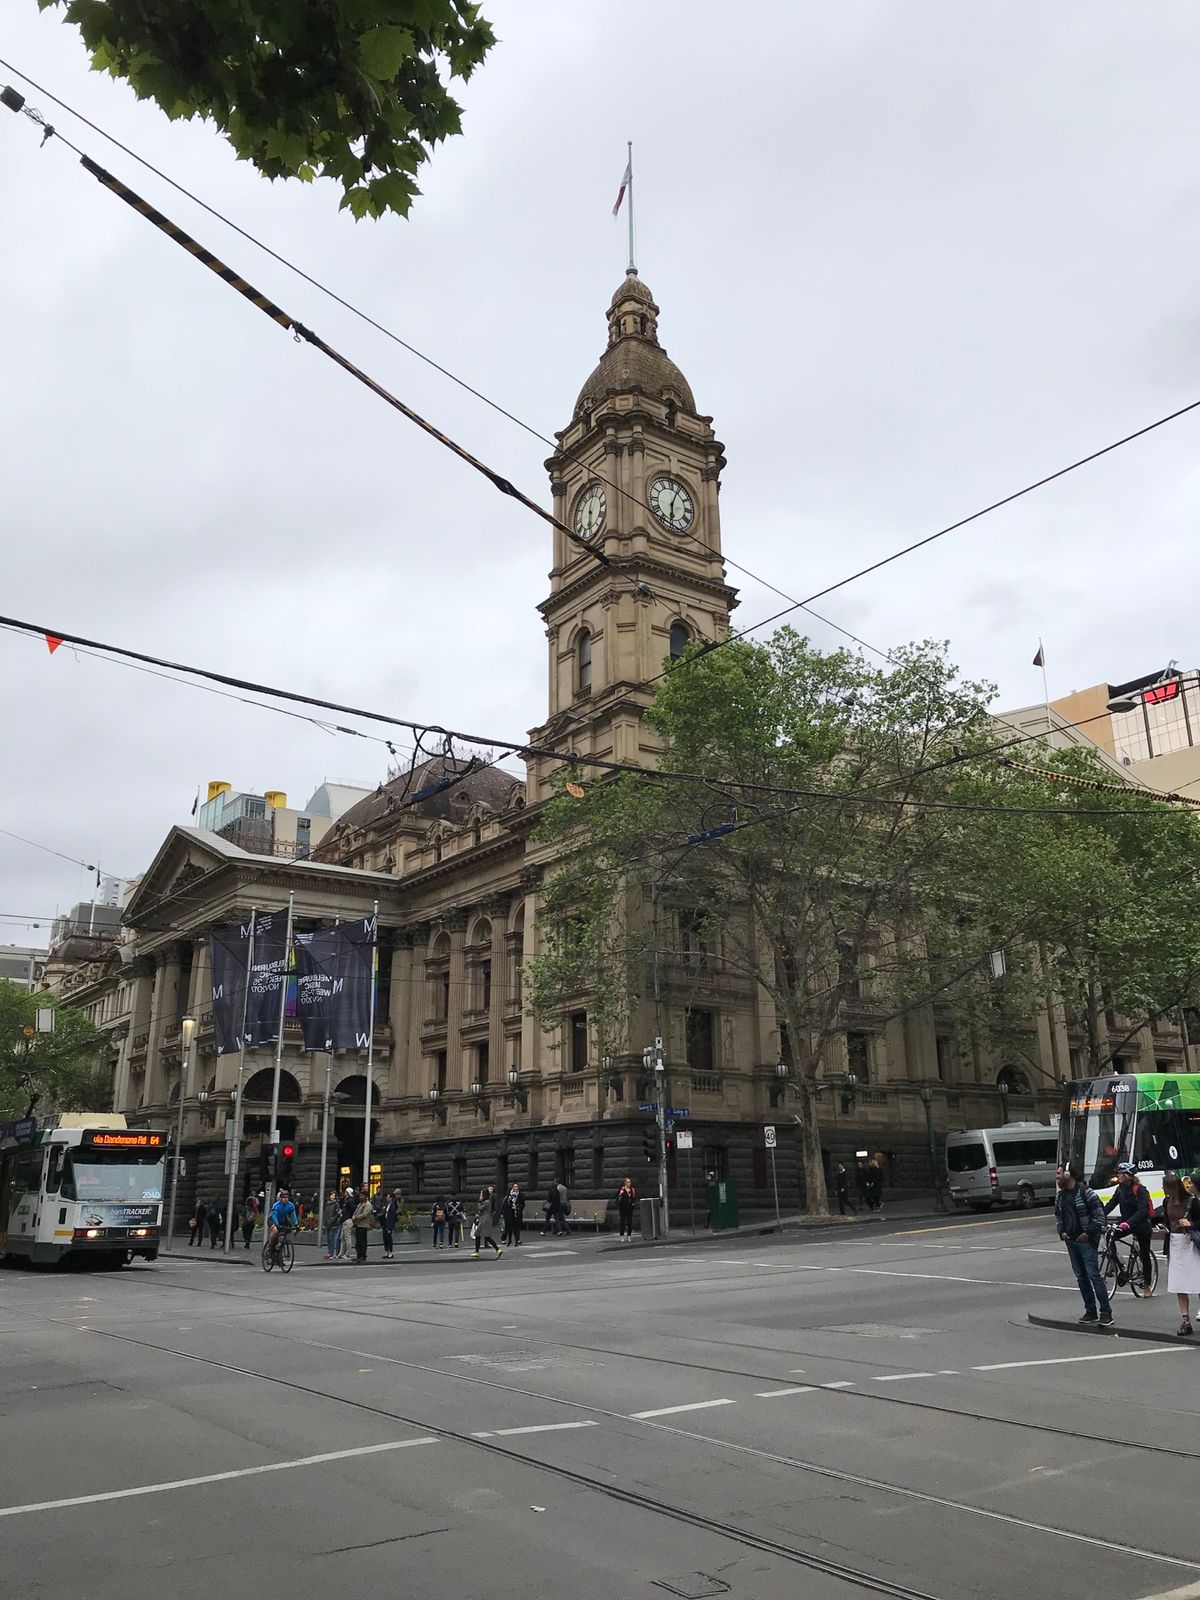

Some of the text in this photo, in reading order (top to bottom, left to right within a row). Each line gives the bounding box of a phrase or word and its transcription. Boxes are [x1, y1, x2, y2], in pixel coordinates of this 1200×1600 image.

[333, 978, 343, 994] M
[212, 984, 223, 1000] M
[1111, 1084, 1130, 1093] 6038
[93, 1135, 103, 1144] via
[138, 1136, 147, 1145] Rd
[150, 1136, 160, 1145] 64
[1138, 1160, 1154, 1169] 6038
